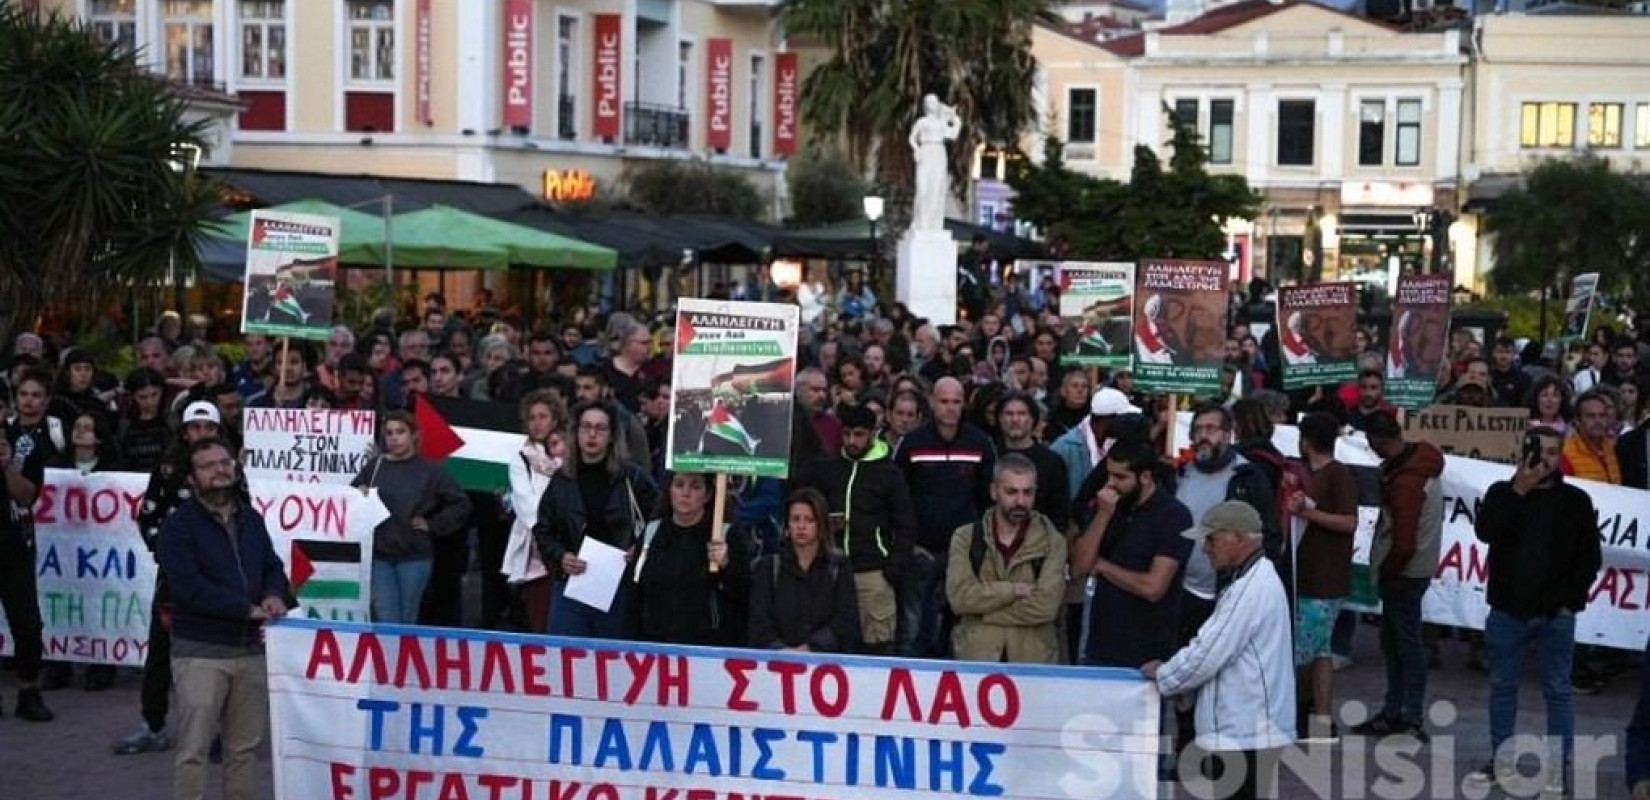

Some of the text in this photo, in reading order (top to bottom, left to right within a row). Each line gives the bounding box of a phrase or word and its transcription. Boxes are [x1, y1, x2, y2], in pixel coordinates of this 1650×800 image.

[508, 14, 528, 105] Public
[598, 32, 617, 117] Public
[711, 54, 729, 132] Public
[777, 69, 795, 139] Public
[690, 314, 780, 330] ΑΛΛΗΛΕΓΓΥΗ
[247, 408, 373, 435] ΑΛΛΗΛΕΓΓΥΗ
[291, 434, 339, 452] ΣΤΟΝ
[1404, 409, 1448, 431] FREE
[45, 590, 147, 630] ΤΗ ΠΑ
[42, 635, 149, 662] ΝΣΠΟΥ
[306, 628, 1020, 729] ΑΛΛΗΛΕΓΓΥΗ ΣΤΟ ΛΑΟ
[356, 699, 1007, 797] ΤΗΣ ΠΑΛΑΙΣΤΙΝΗΣ
